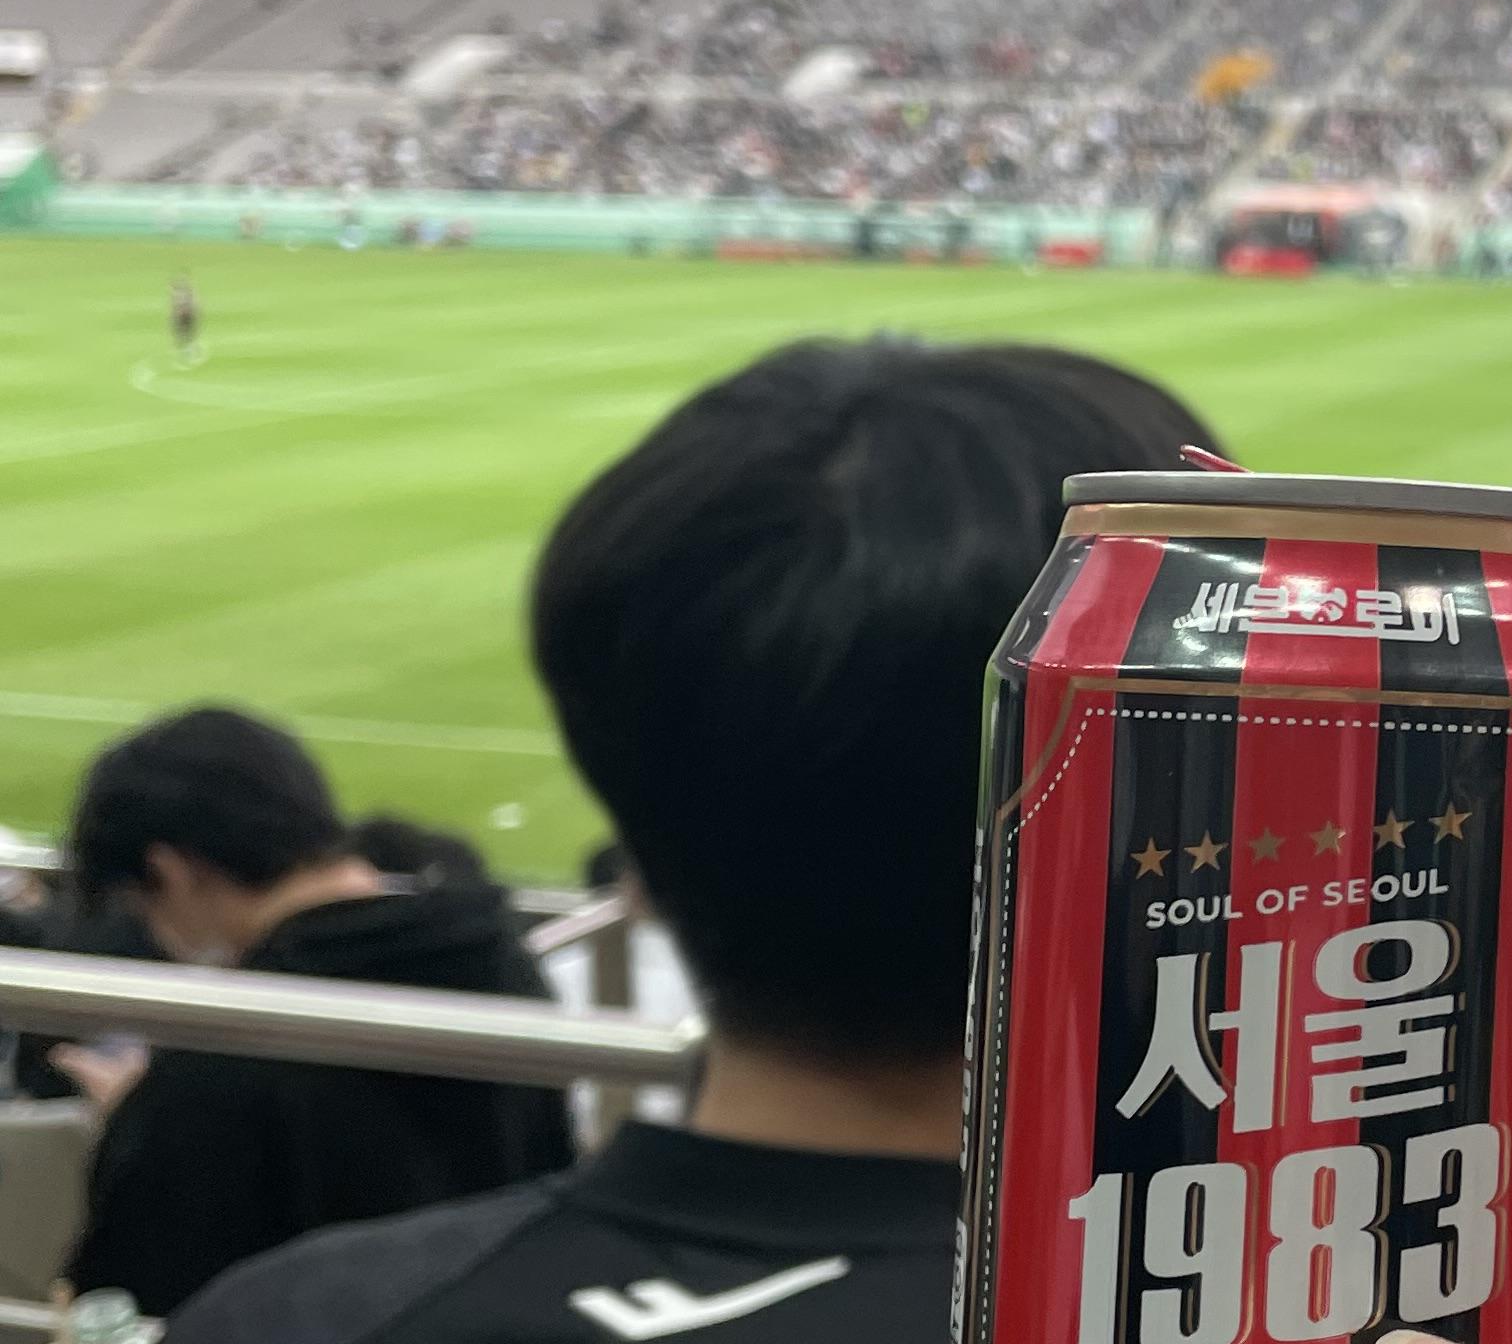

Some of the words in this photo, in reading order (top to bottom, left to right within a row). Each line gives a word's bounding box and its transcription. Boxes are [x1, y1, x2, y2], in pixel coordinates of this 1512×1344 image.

[1145, 894, 1244, 930] SOUL
[1255, 884, 1309, 915] OF
[1322, 867, 1449, 907] SEOUL
[1114, 918, 1461, 1134] 서울
